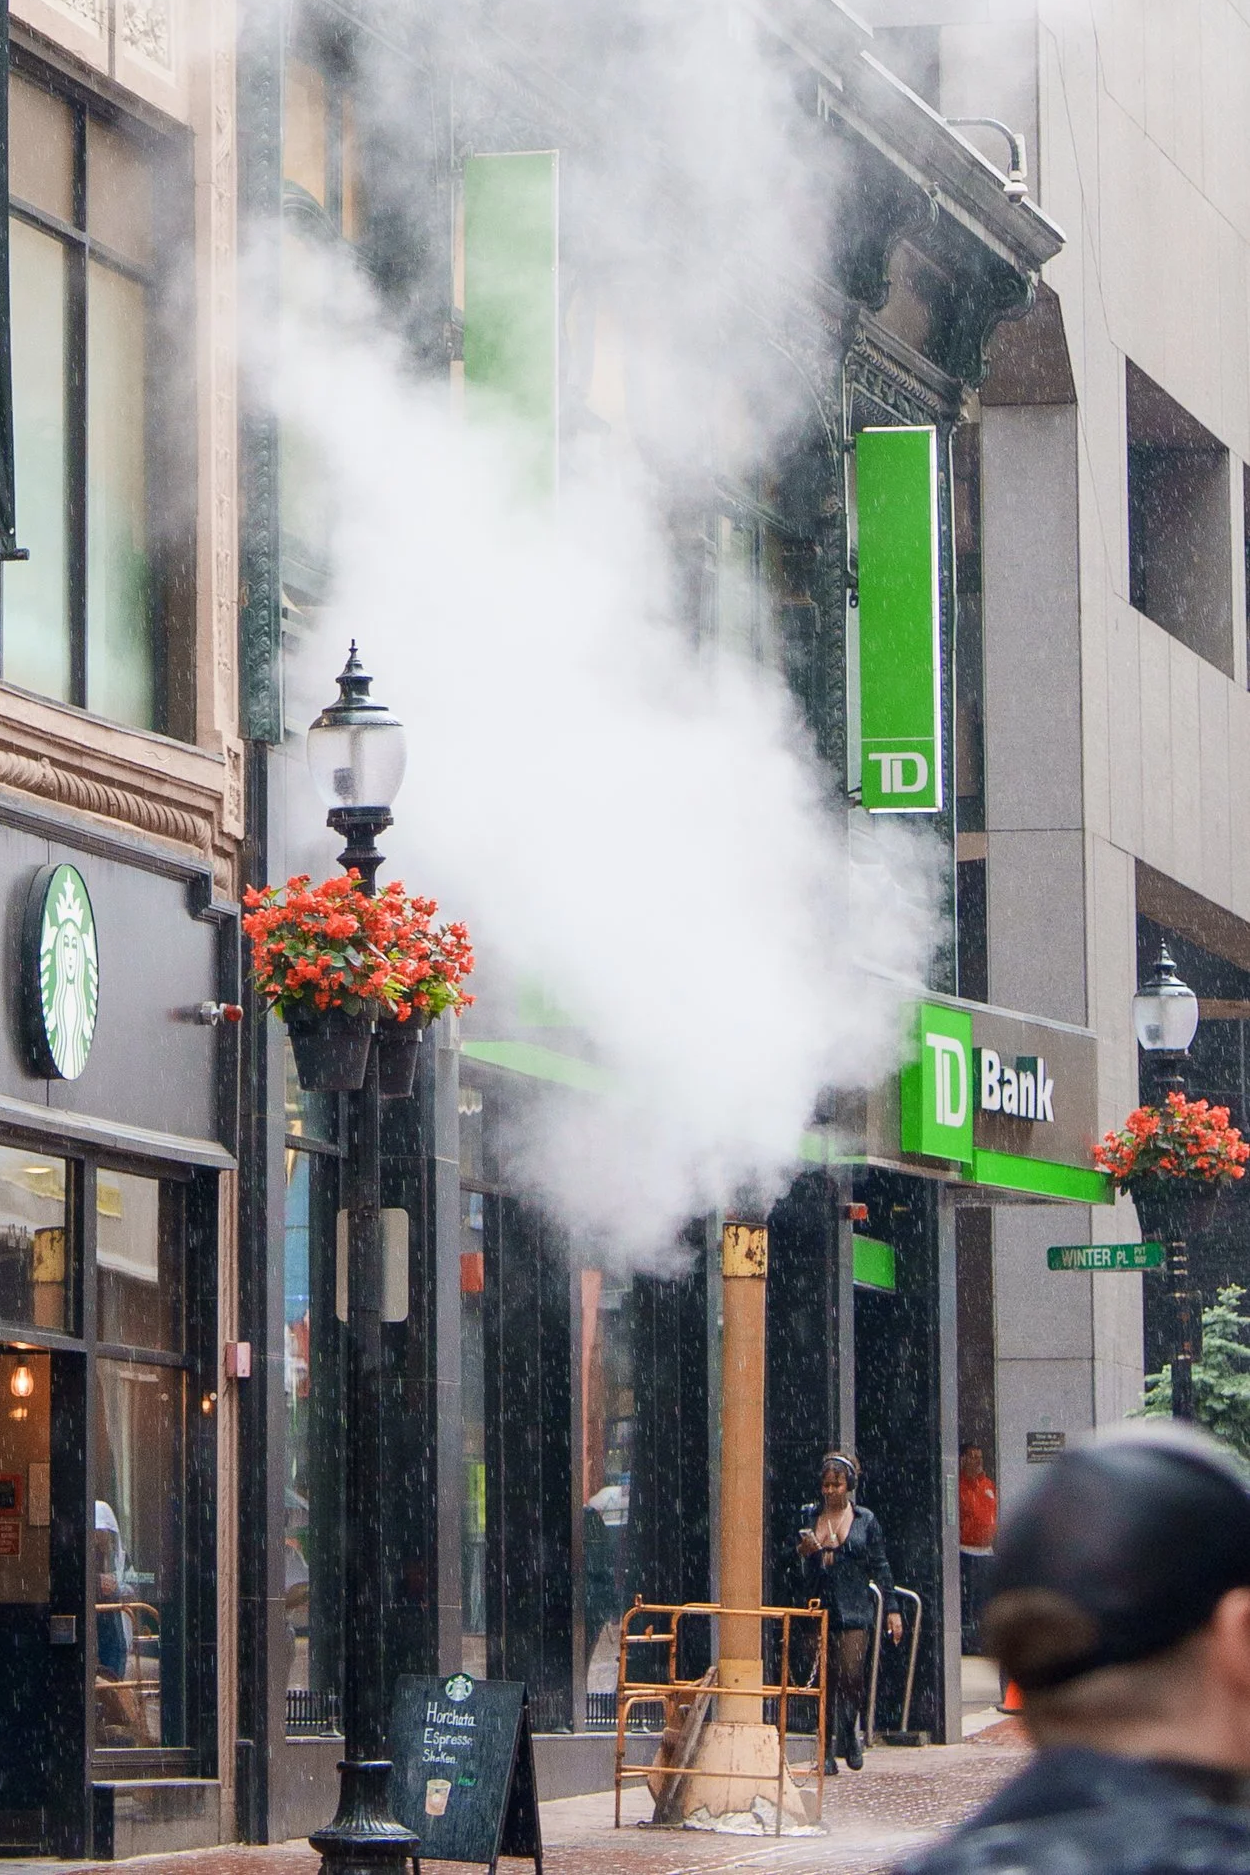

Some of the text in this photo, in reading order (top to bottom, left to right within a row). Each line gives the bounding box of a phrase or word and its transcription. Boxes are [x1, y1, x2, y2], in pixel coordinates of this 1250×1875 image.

[868, 752, 928, 793] TD
[926, 1032, 1055, 1128] TD Bank
[1062, 1248, 1129, 1266] WINTER PL
[426, 1701, 478, 1727] Horchata
